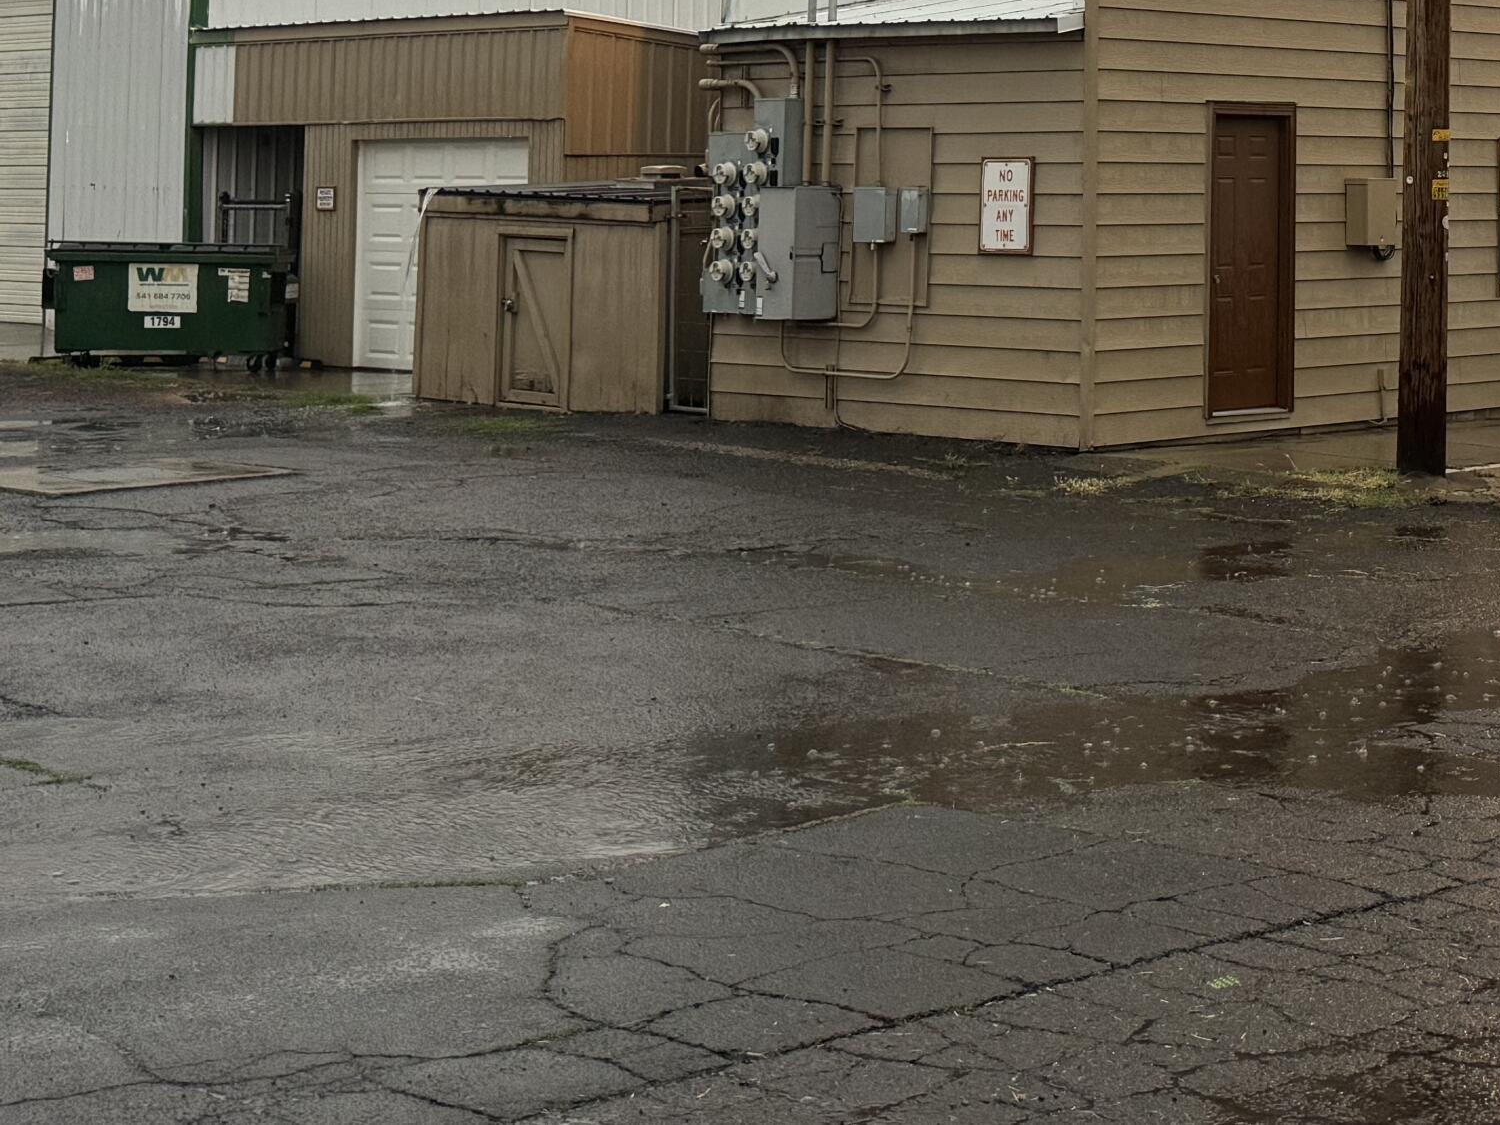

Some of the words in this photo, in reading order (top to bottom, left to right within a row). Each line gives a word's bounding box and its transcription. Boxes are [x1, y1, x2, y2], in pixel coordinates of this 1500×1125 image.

[999, 169, 1013, 182] NO
[987, 189, 1024, 203] PARKING
[995, 209, 1014, 223] ANY
[995, 229, 1015, 242] TIME
[136, 267, 187, 282] WM
[150, 316, 175, 327] 1794
